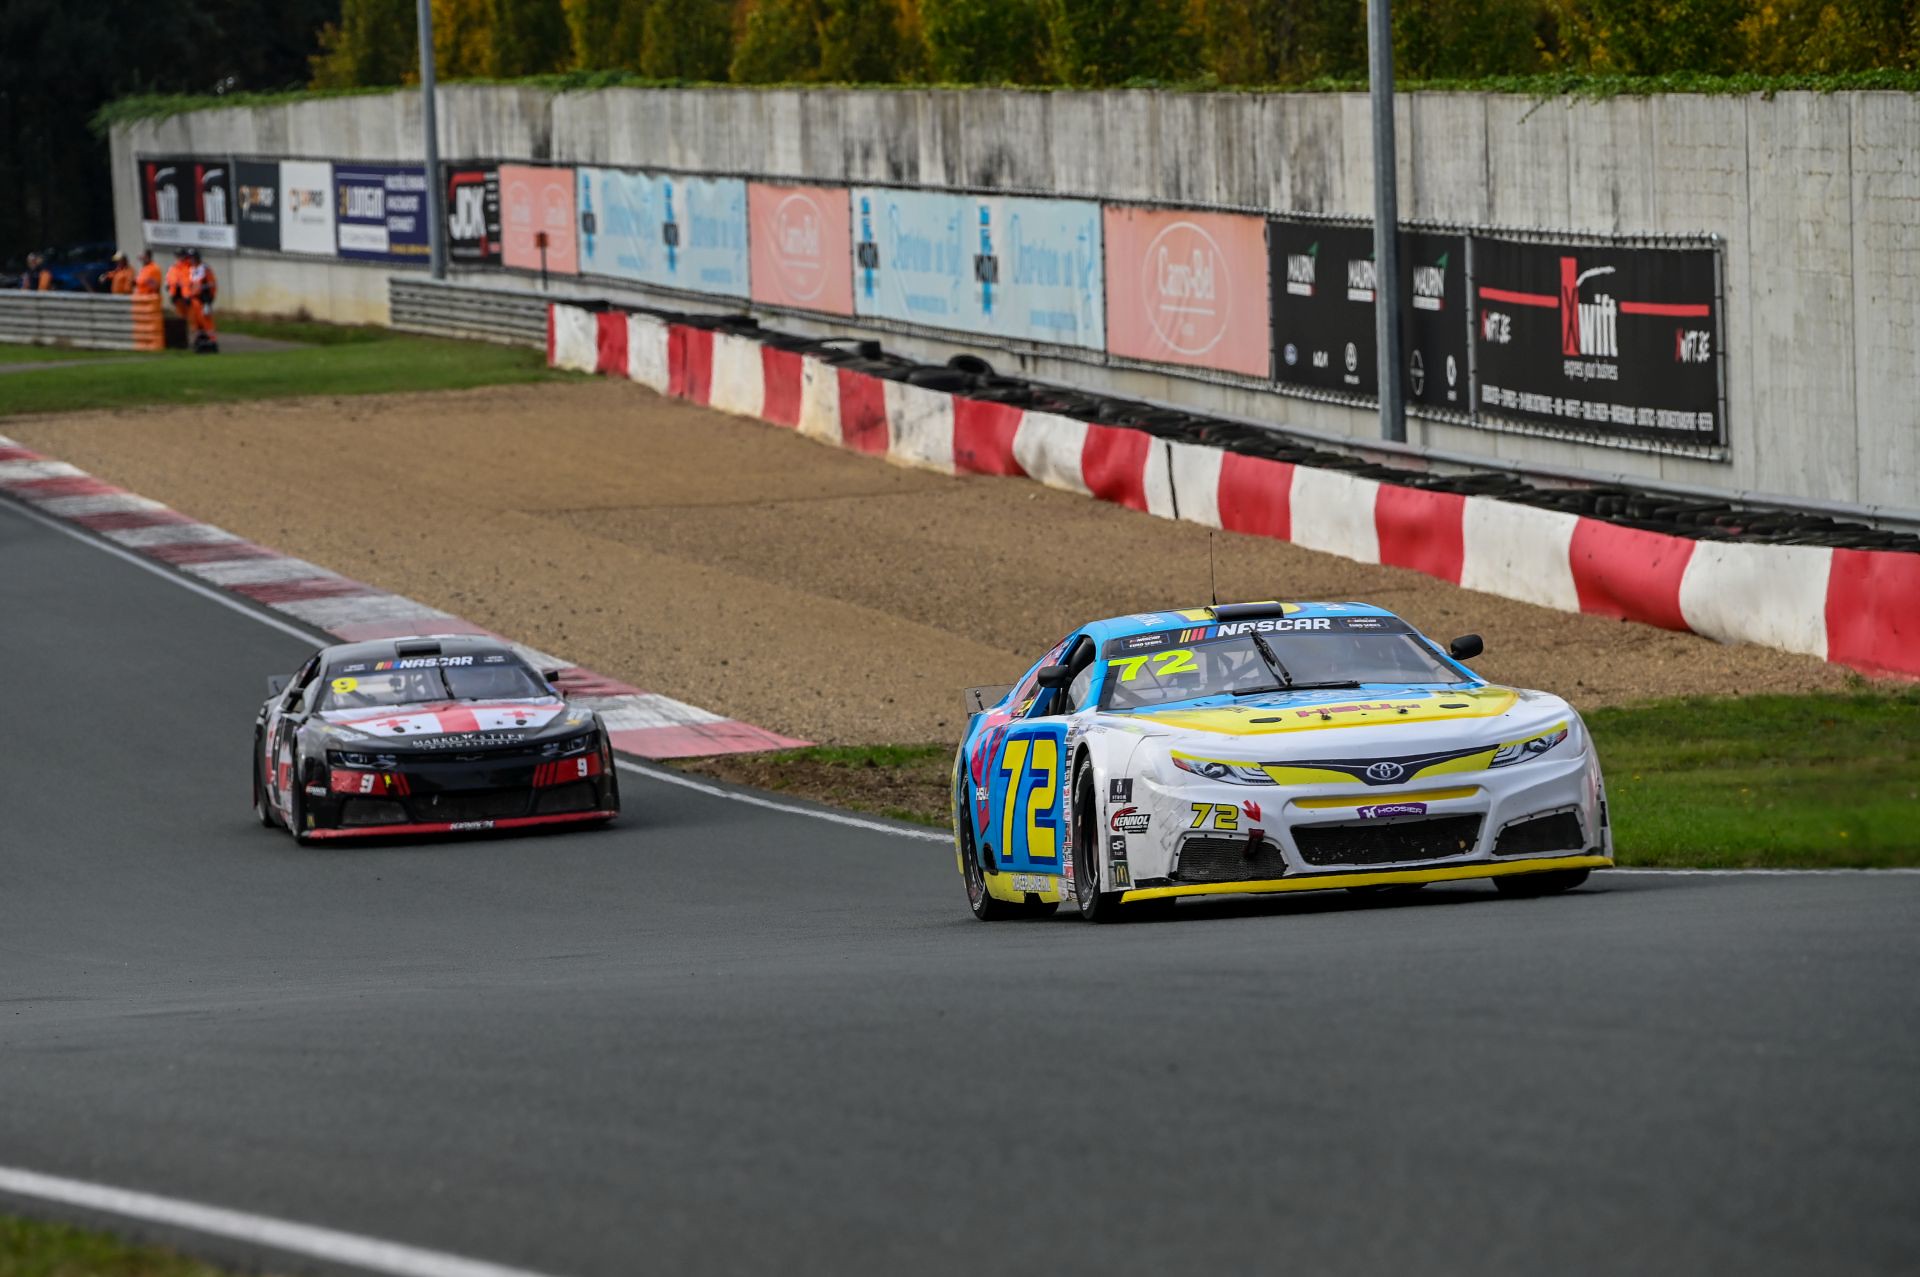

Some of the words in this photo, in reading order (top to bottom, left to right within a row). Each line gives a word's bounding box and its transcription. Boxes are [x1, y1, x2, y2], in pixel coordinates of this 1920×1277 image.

[1217, 618, 1331, 638] NASCAR
[399, 656, 473, 669] NASCAR
[1108, 649, 1198, 682] 72
[577, 757, 588, 777] 9
[359, 774, 375, 793] 9
[1001, 738, 1058, 858] 72
[1190, 802, 1239, 830] 72
[1377, 805, 1423, 815] HOOSIER
[1113, 815, 1149, 827] KENNOL
